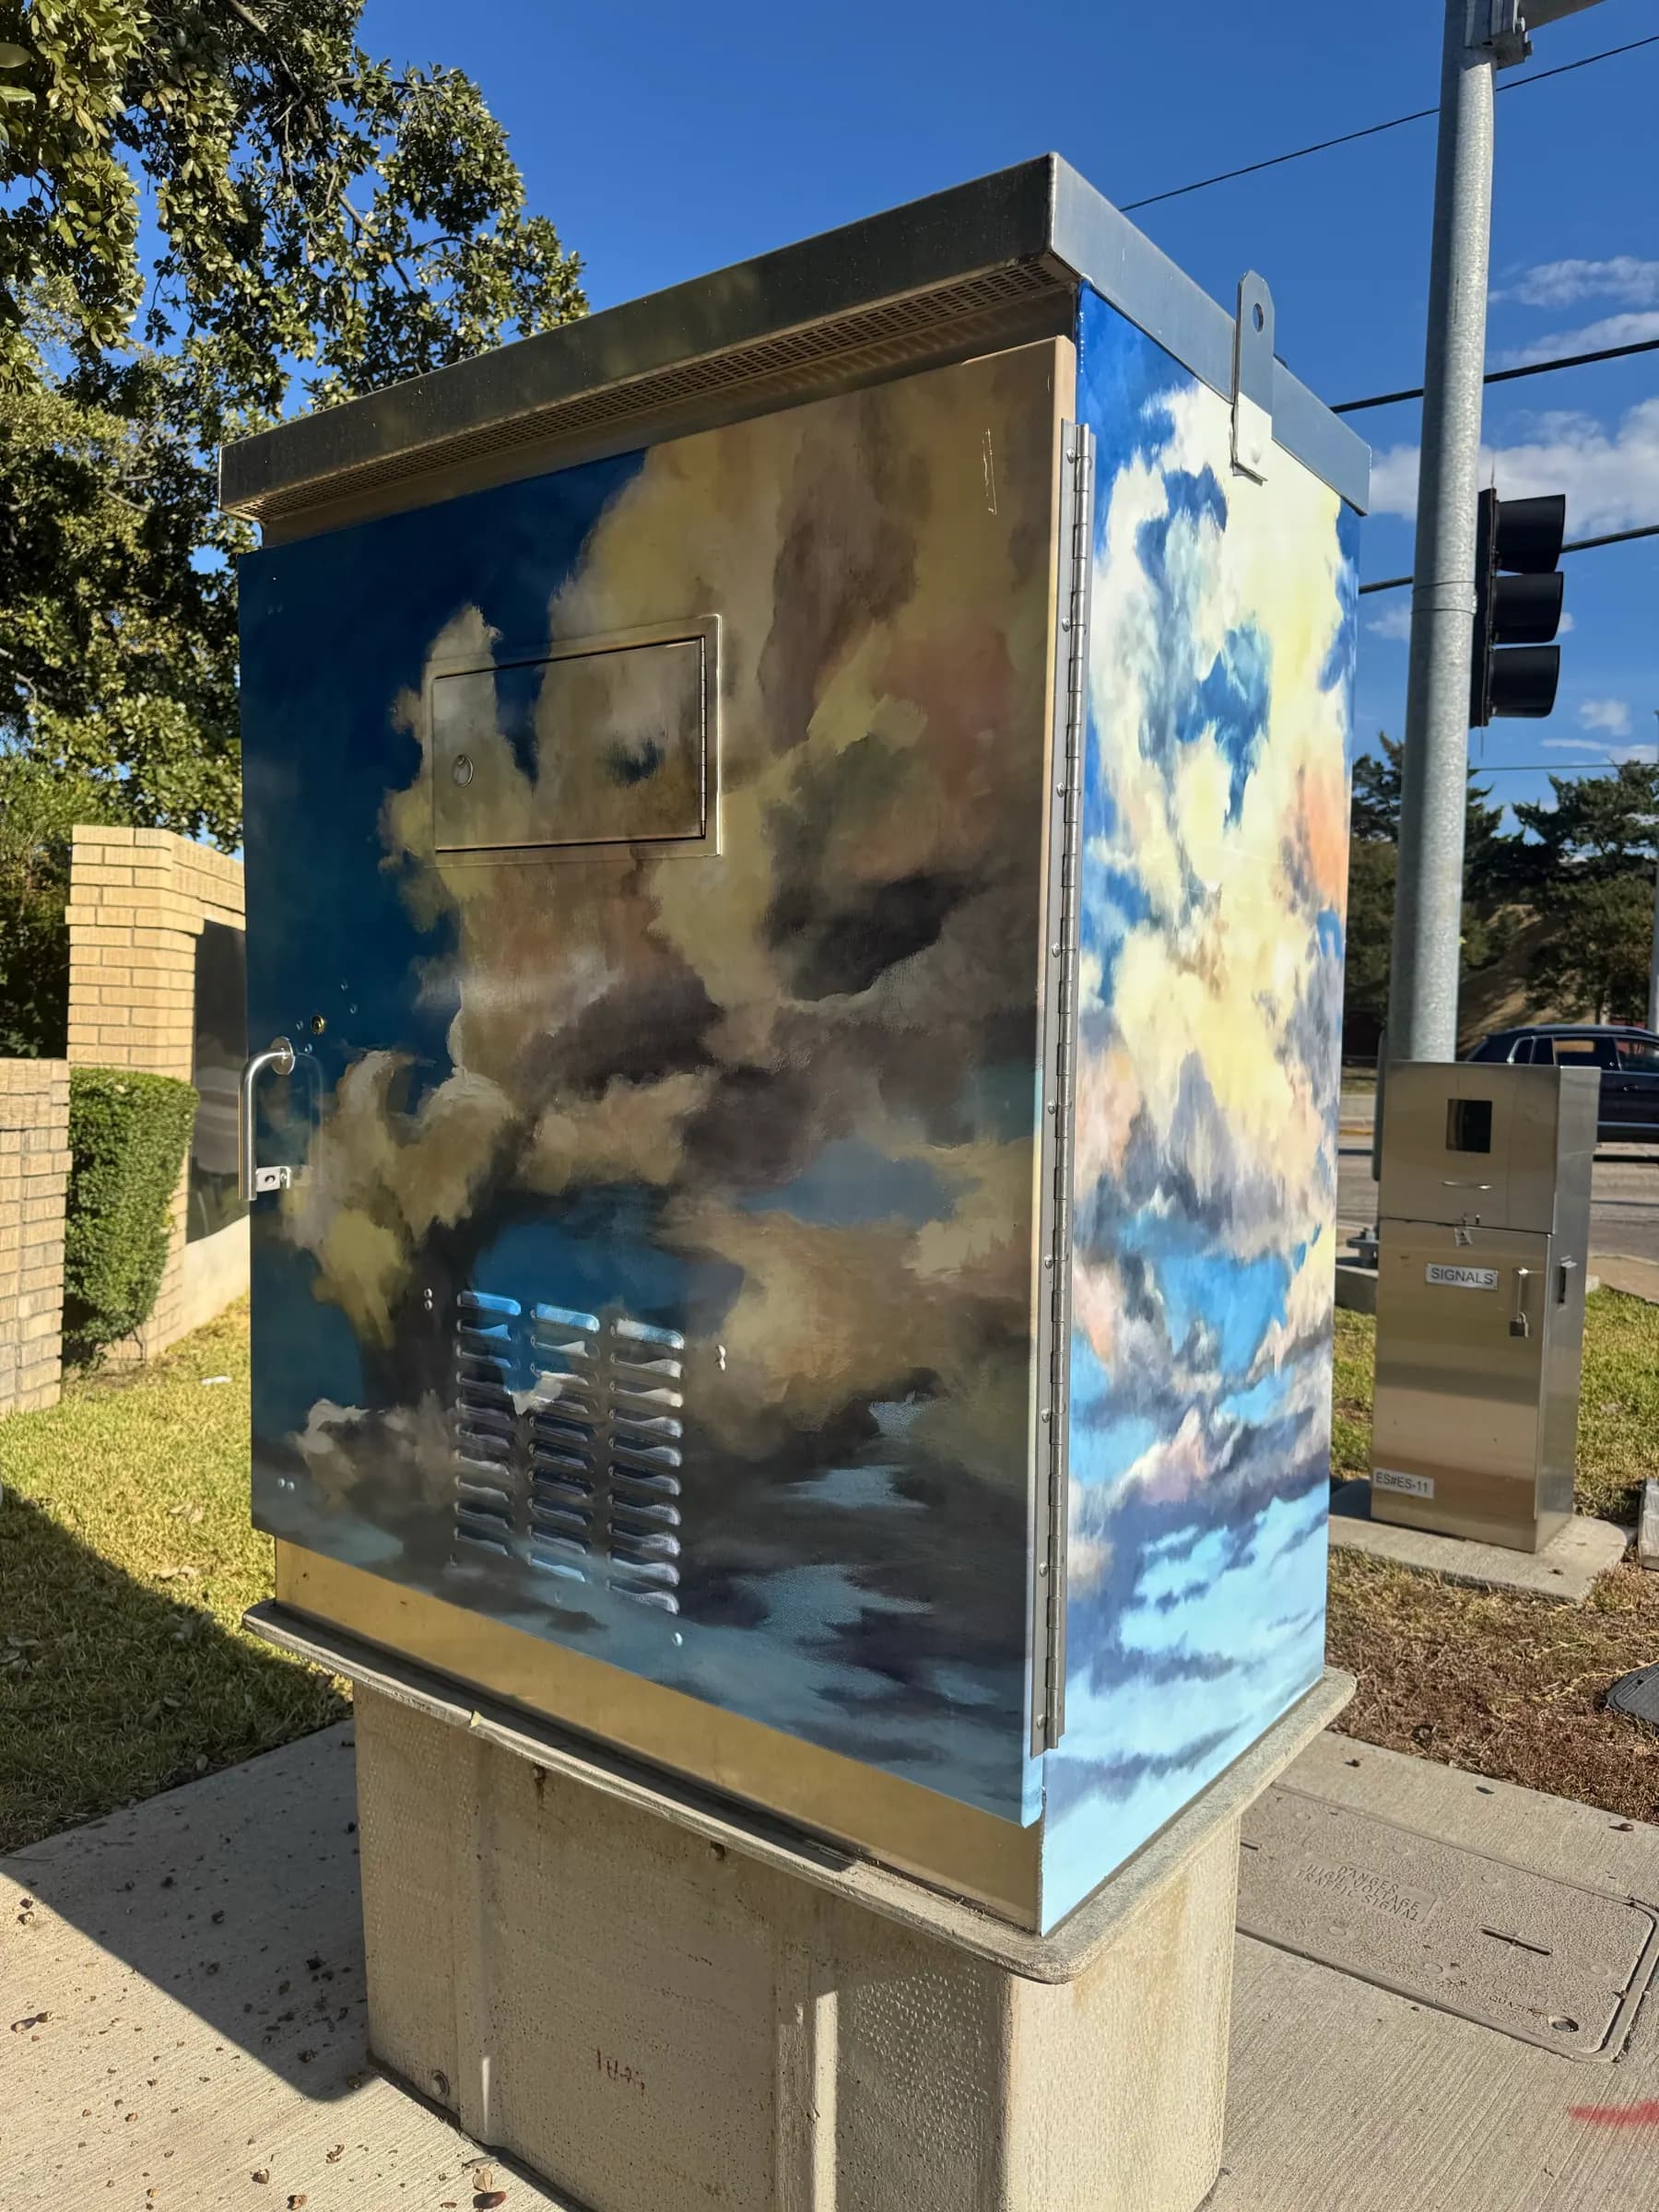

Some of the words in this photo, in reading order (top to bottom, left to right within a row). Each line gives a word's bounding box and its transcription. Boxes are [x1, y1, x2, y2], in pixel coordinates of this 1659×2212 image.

[1430, 1267, 1493, 1285] SIGNALS
[1376, 1471, 1428, 1492] ES#ES-11
[1306, 1864, 1346, 1883] HIGH
[1353, 1879, 1420, 1911] VOLTAGE
[1337, 1865, 1399, 1893] DANGER
[1296, 1869, 1357, 1898] TRAFFIC
[1360, 1894, 1418, 1921] SIGNAL
